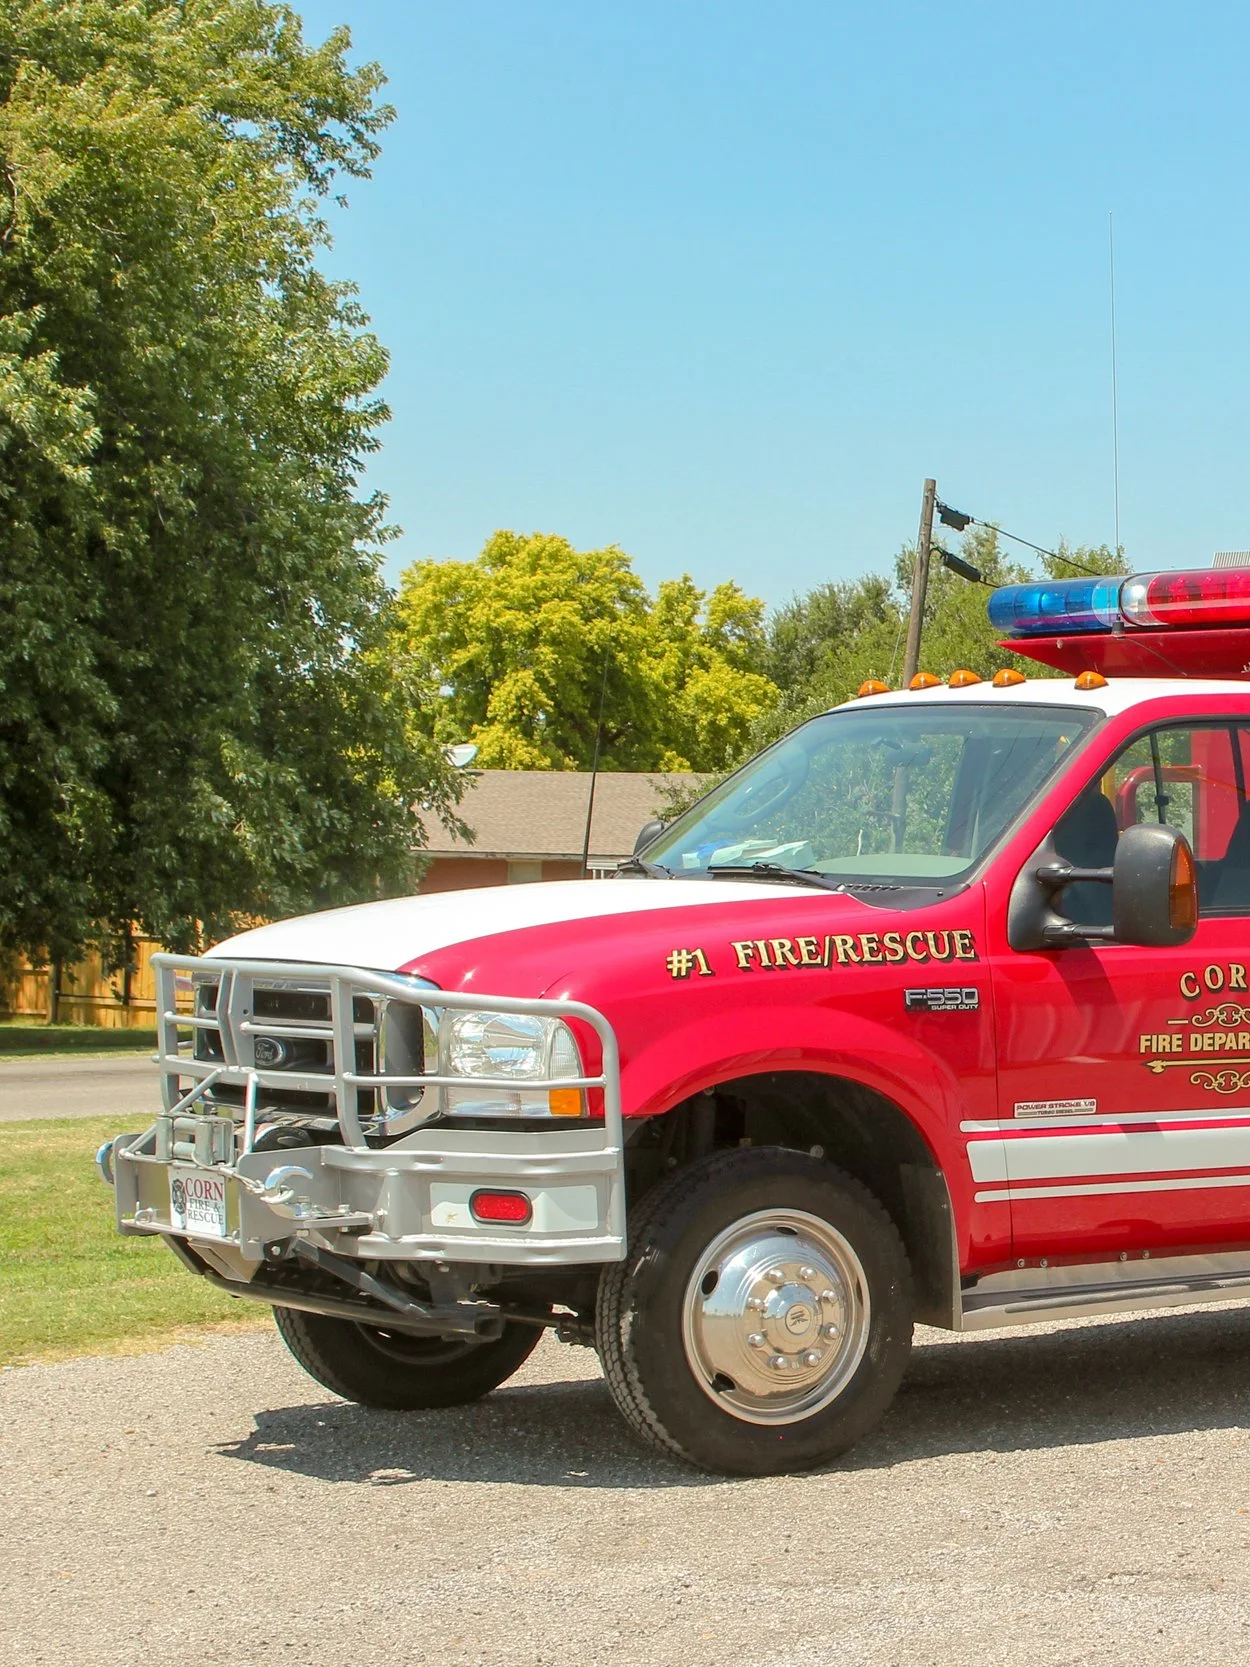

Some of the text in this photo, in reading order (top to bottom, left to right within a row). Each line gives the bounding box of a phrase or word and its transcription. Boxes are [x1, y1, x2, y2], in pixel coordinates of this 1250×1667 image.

[665, 929, 981, 979] #1 FIRE/RESCUE
[904, 988, 979, 1006] F-550
[1139, 1033, 1183, 1054] FIRE
[1048, 1101, 1082, 1109] STROKE
[185, 1177, 224, 1202] CORN
[189, 1197, 211, 1212] FIRE
[187, 1208, 225, 1225] RESCUE
